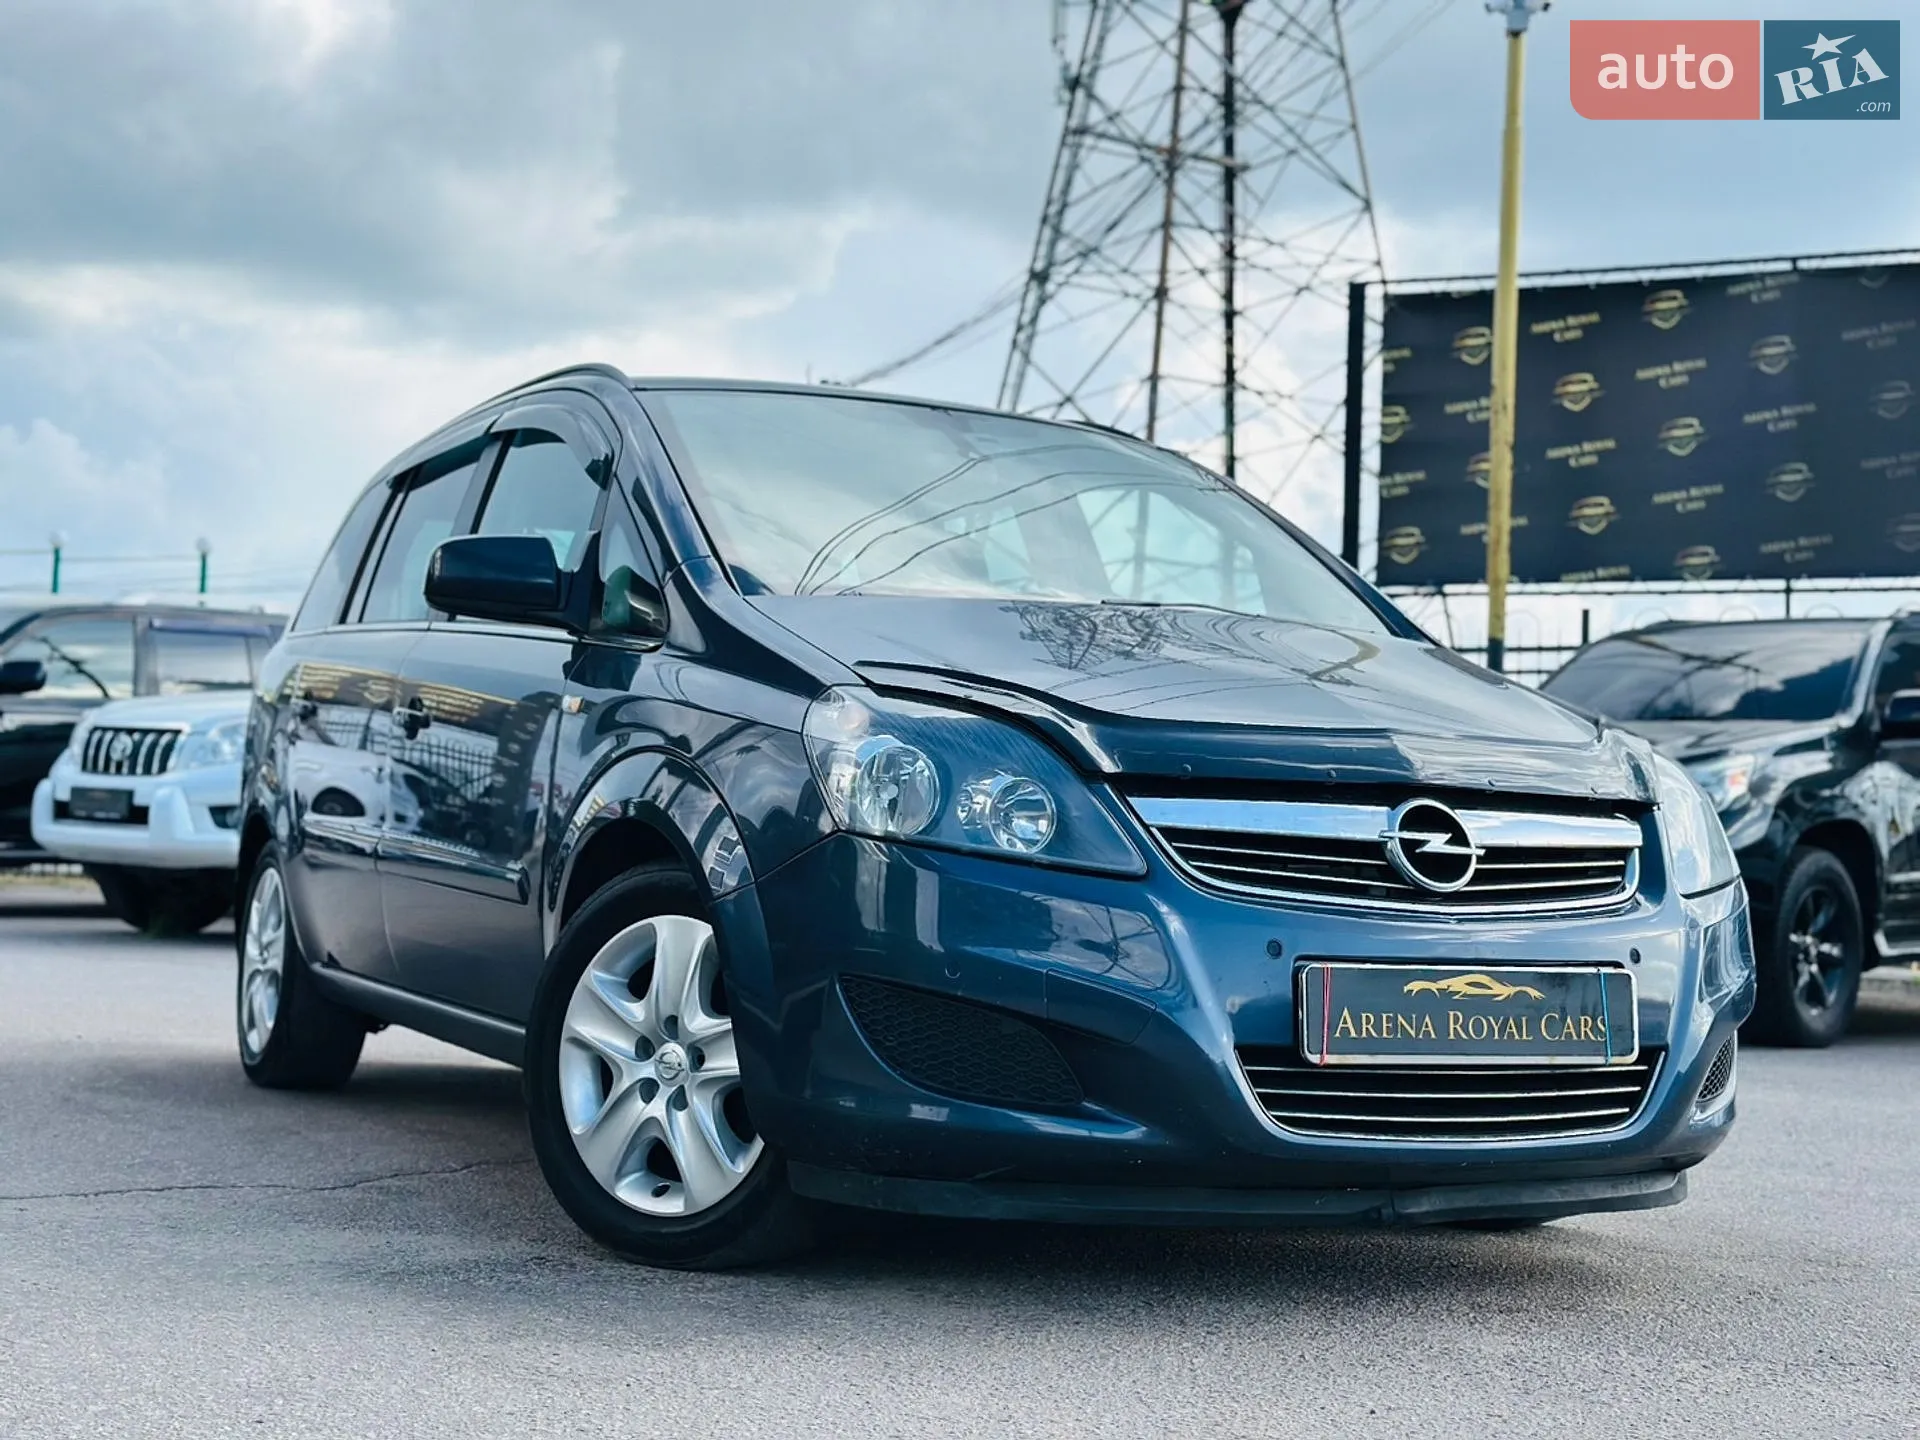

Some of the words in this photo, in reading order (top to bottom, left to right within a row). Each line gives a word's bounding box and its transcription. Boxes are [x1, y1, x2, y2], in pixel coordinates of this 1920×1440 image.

[1334, 1007, 1437, 1039] ARENA
[1448, 1010, 1533, 1041] ROYAL
[1541, 1013, 1608, 1042] CARS
